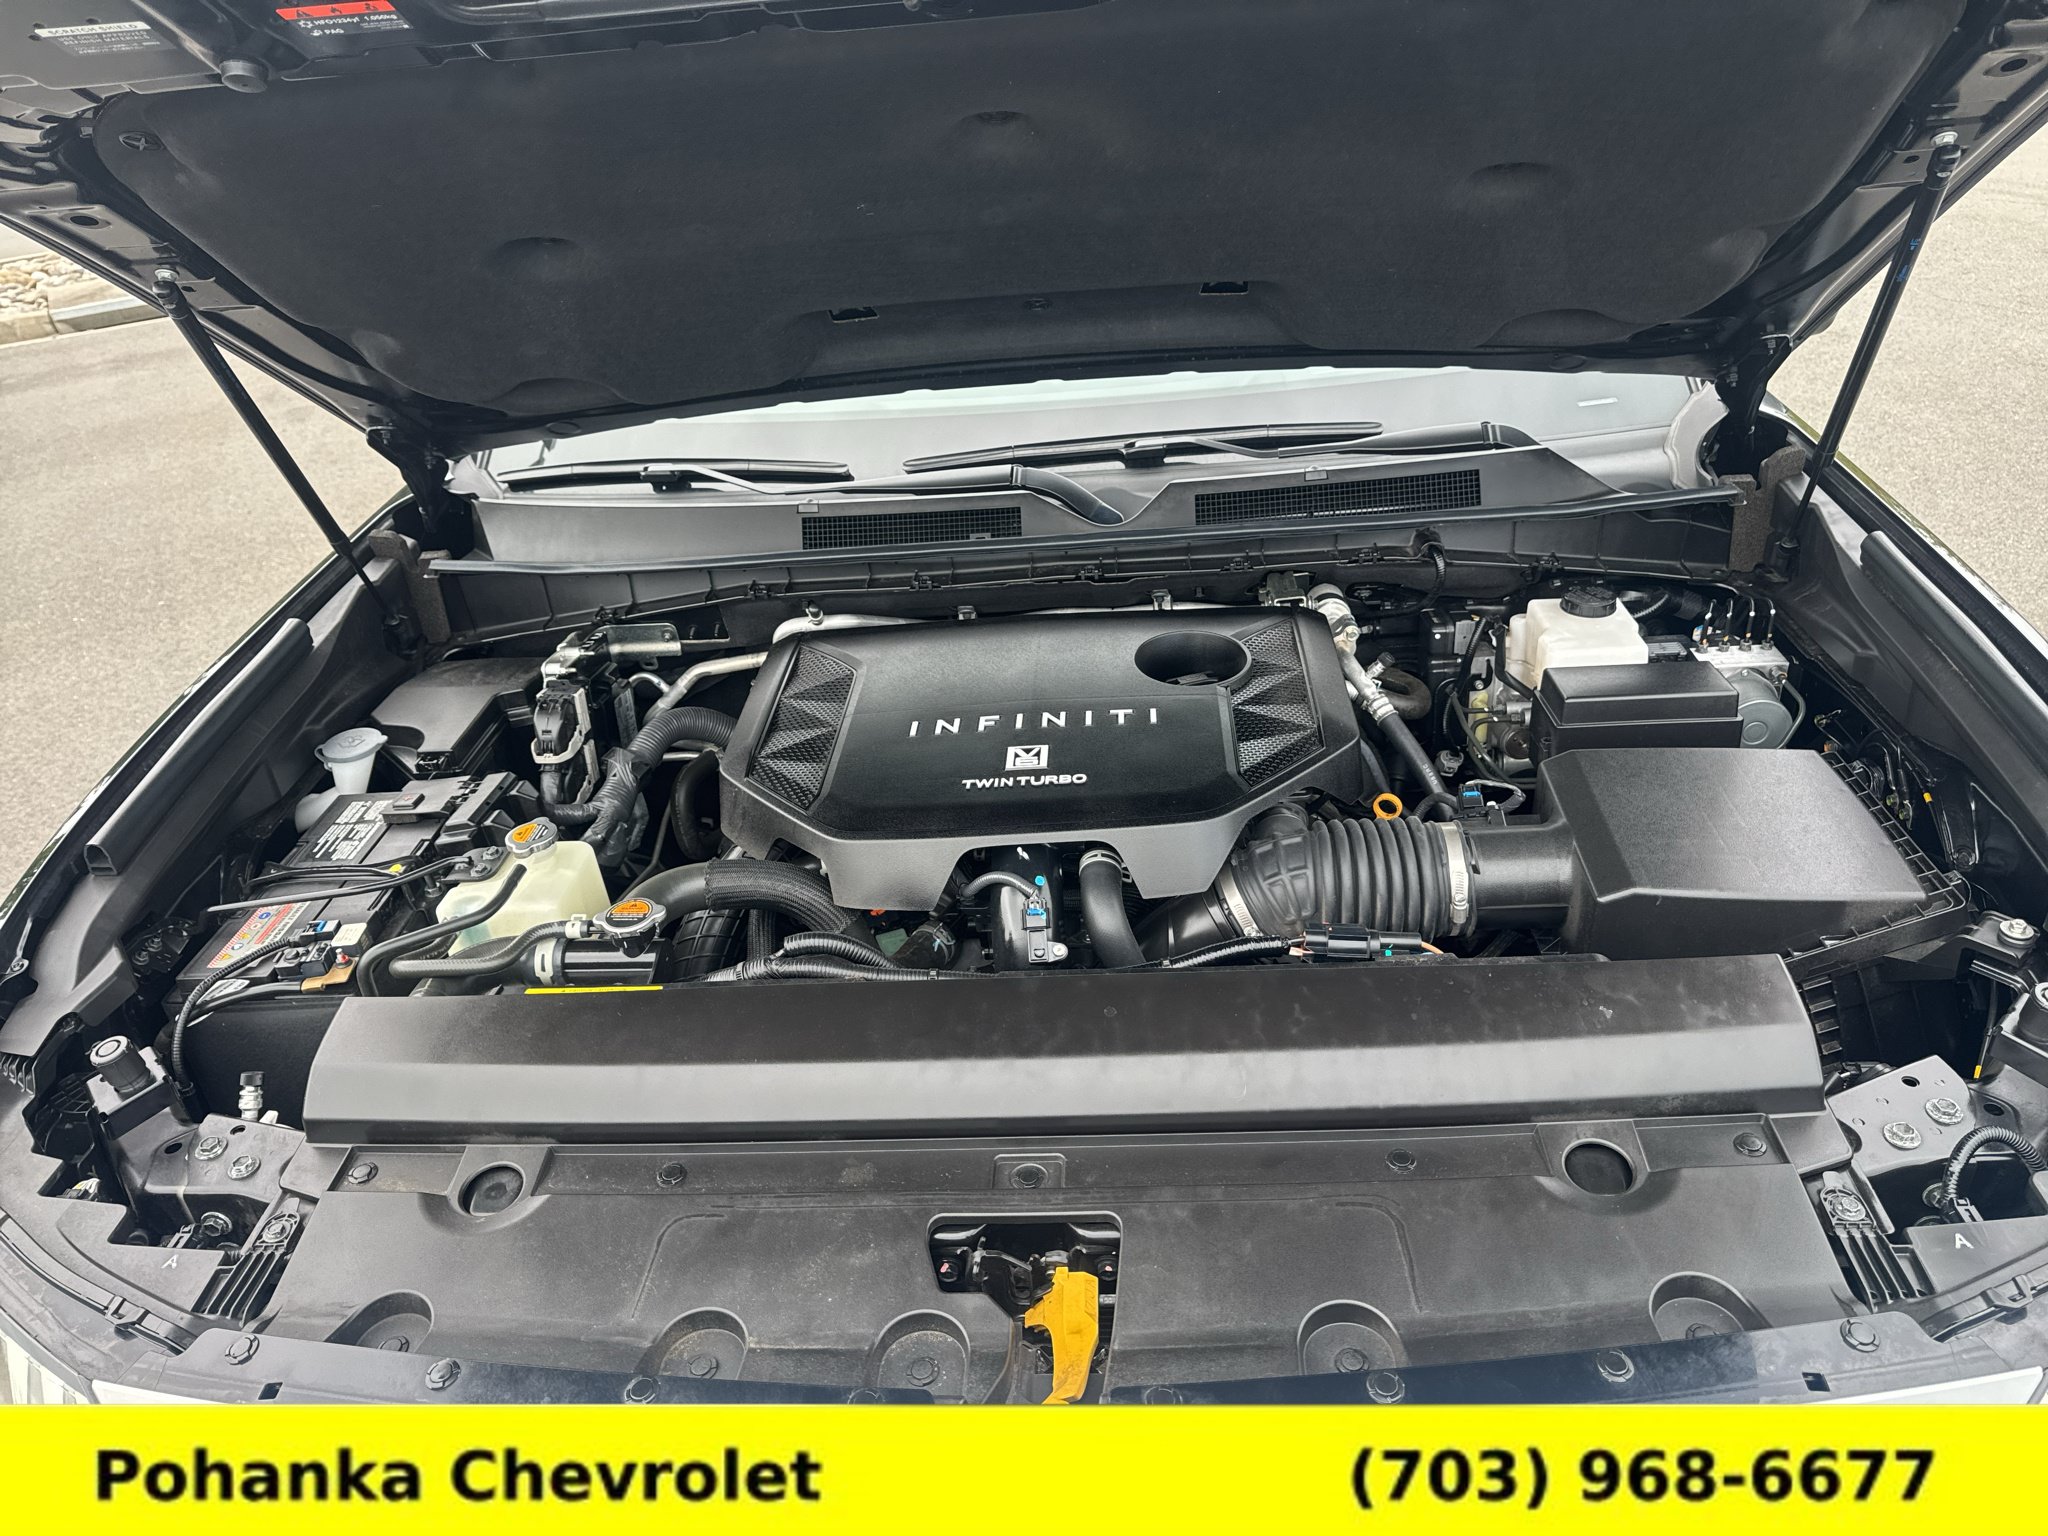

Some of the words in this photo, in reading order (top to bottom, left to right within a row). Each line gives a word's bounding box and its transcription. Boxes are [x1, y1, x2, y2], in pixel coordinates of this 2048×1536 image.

[48, 26, 97, 36] SCRATCH
[99, 23, 138, 32] SHIELD
[104, 34, 151, 42] MATERIALS
[909, 707, 1158, 738] INFINITI
[961, 776, 1014, 790] TWIN
[1016, 773, 1088, 787] TURBO
[1954, 1233, 1974, 1249] A
[160, 1254, 178, 1270] A
